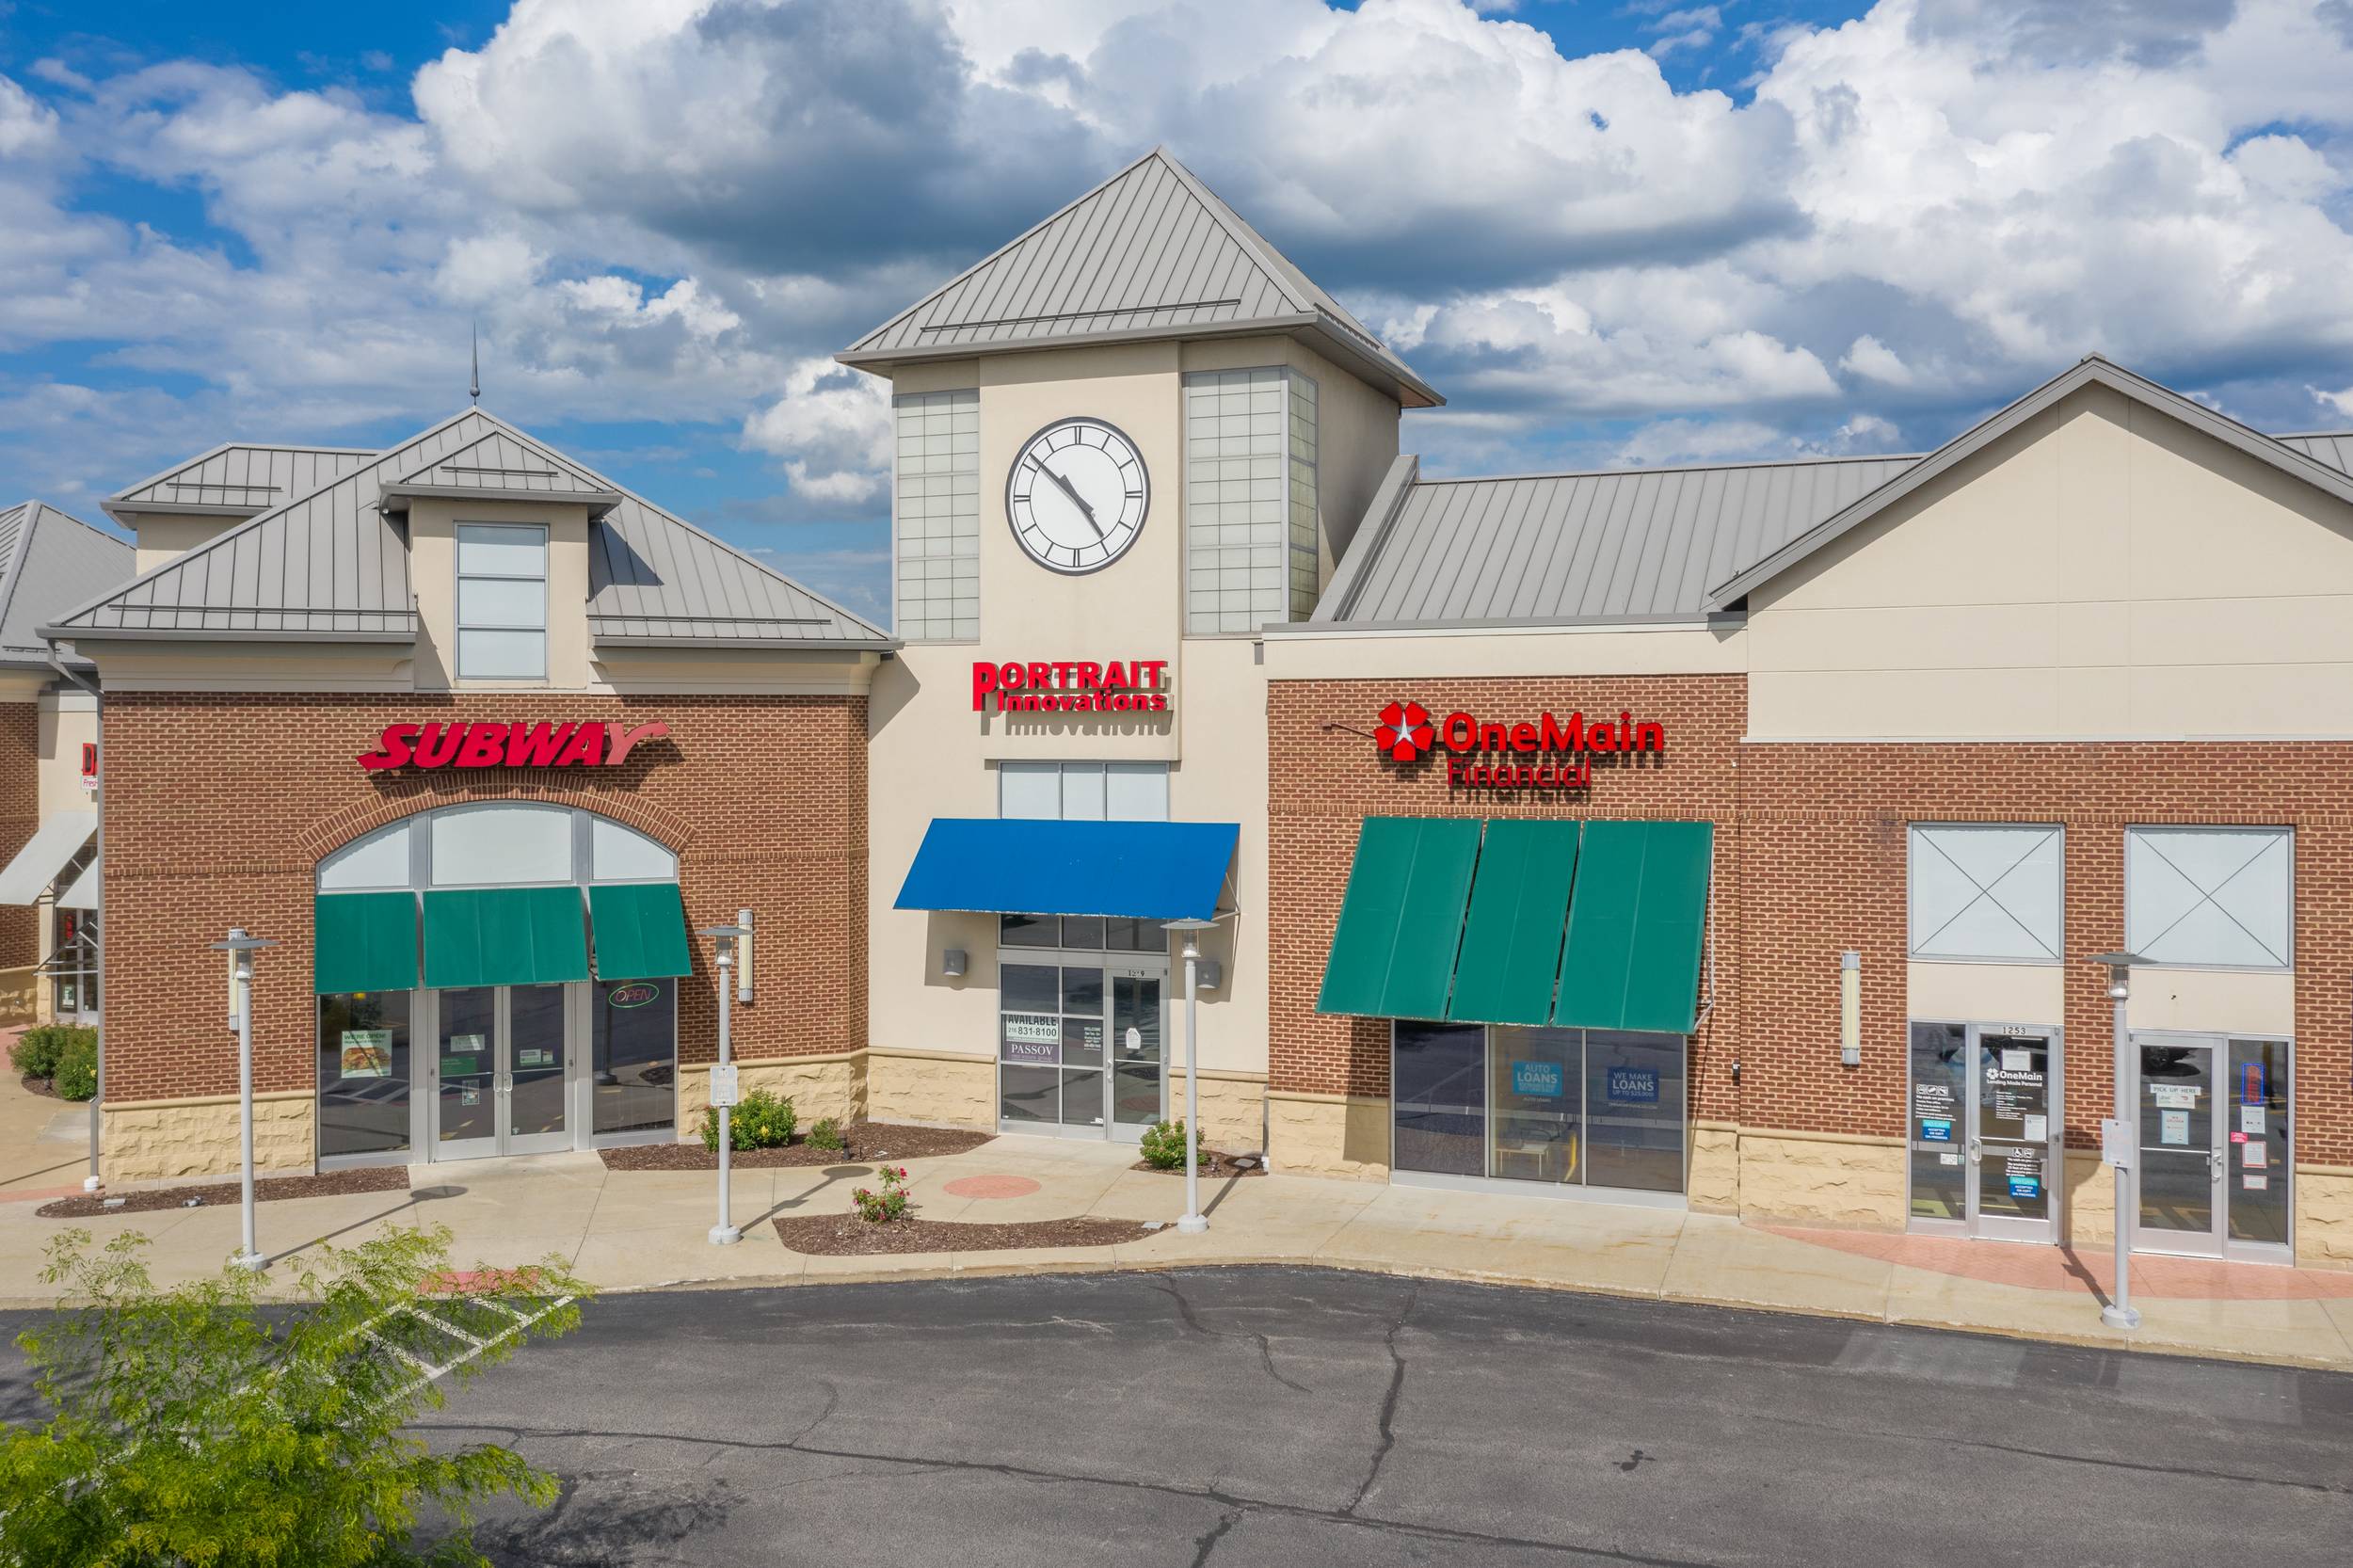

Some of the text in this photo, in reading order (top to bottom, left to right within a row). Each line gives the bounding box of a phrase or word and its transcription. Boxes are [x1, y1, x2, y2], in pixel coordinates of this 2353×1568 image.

[972, 661, 1167, 712] PORTRAIT
[998, 690, 1167, 712] Innovations
[1442, 712, 1665, 752] OneMain
[356, 719, 671, 771] SUBWAY
[1447, 756, 1592, 788] Financial
[616, 988, 652, 1002] OPEN
[1008, 1015, 1057, 1027] AVAILABLE
[1017, 1026, 1057, 1037] 831-8100
[2002, 1026, 2026, 1035] 1253
[1011, 1044, 1053, 1056] PASSOV
[1525, 1064, 1551, 1074] AUTO
[1999, 1070, 2042, 1080] OneMain
[1517, 1072, 1559, 1084] LOANS
[1629, 1073, 1653, 1081] MAKE
[1612, 1079, 1655, 1092] LOANS
